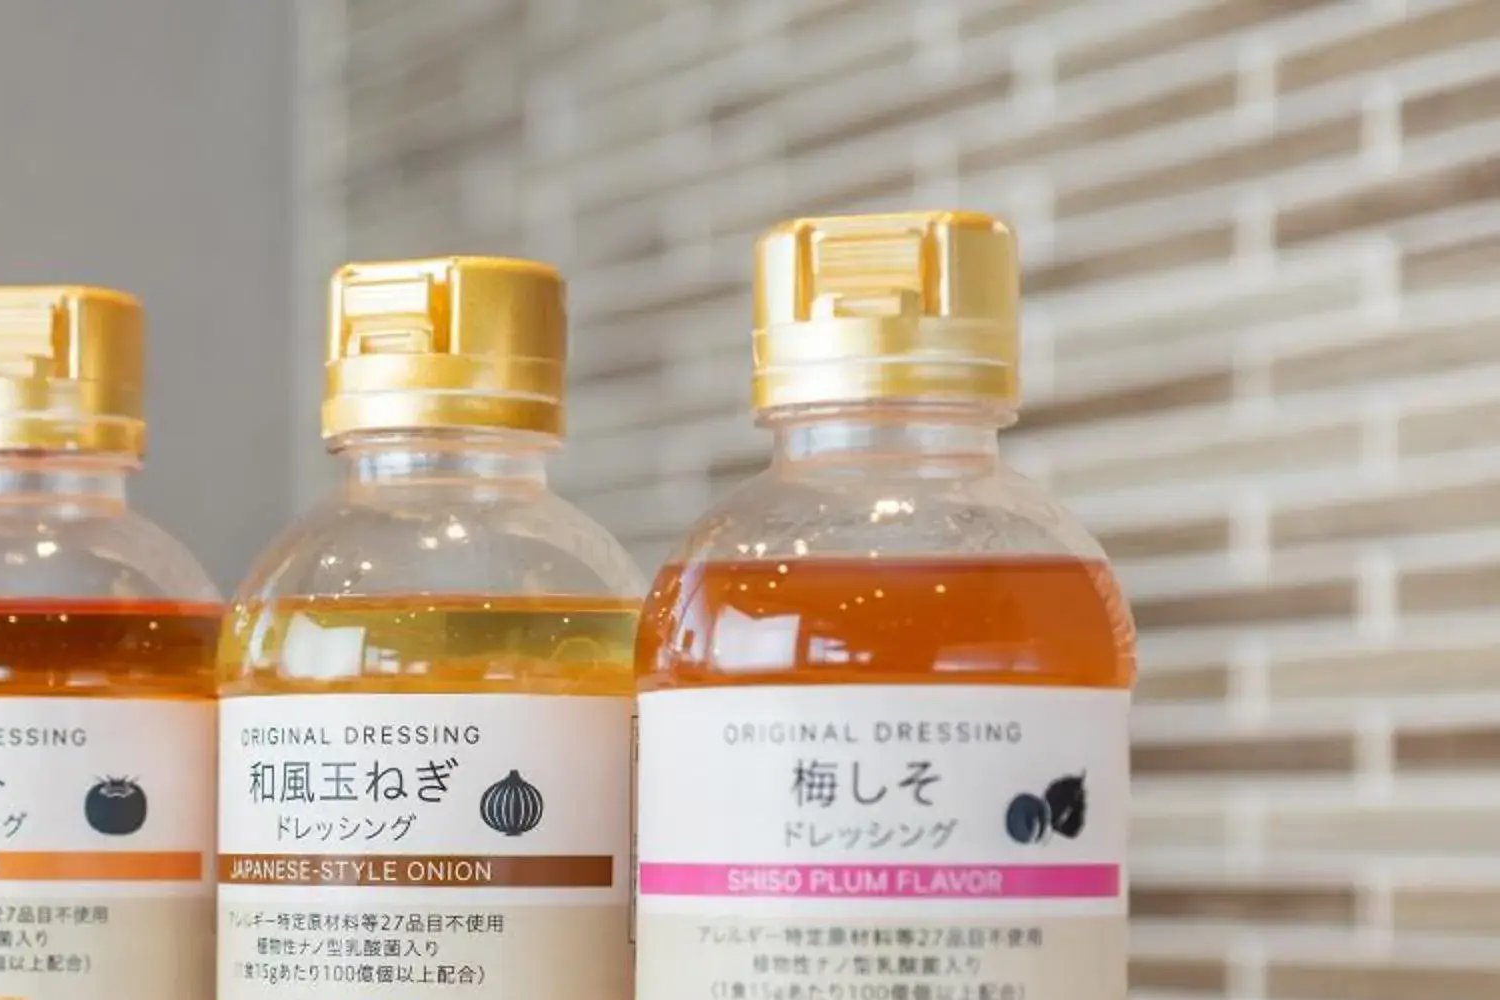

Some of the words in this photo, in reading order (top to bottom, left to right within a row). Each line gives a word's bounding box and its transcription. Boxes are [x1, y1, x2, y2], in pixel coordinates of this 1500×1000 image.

[241, 727, 332, 747] ORIGINAL
[344, 725, 482, 745] DRESSING
[723, 722, 858, 744] ORIGINAL
[874, 722, 1023, 744] DRESSING
[249, 757, 459, 804] 和風玉ねぎ
[790, 759, 942, 809] 梅しそ
[275, 813, 417, 842] ドレッシング
[783, 818, 959, 850] ドレッシング
[228, 859, 397, 882] JAPANESE-STYLE
[406, 860, 492, 882] ONION
[726, 869, 801, 893] SHISO
[809, 869, 889, 893] PLUM
[896, 869, 1004, 894] FLAVOR
[256, 938, 439, 958] 植物性ナノ型乳酸菌入り
